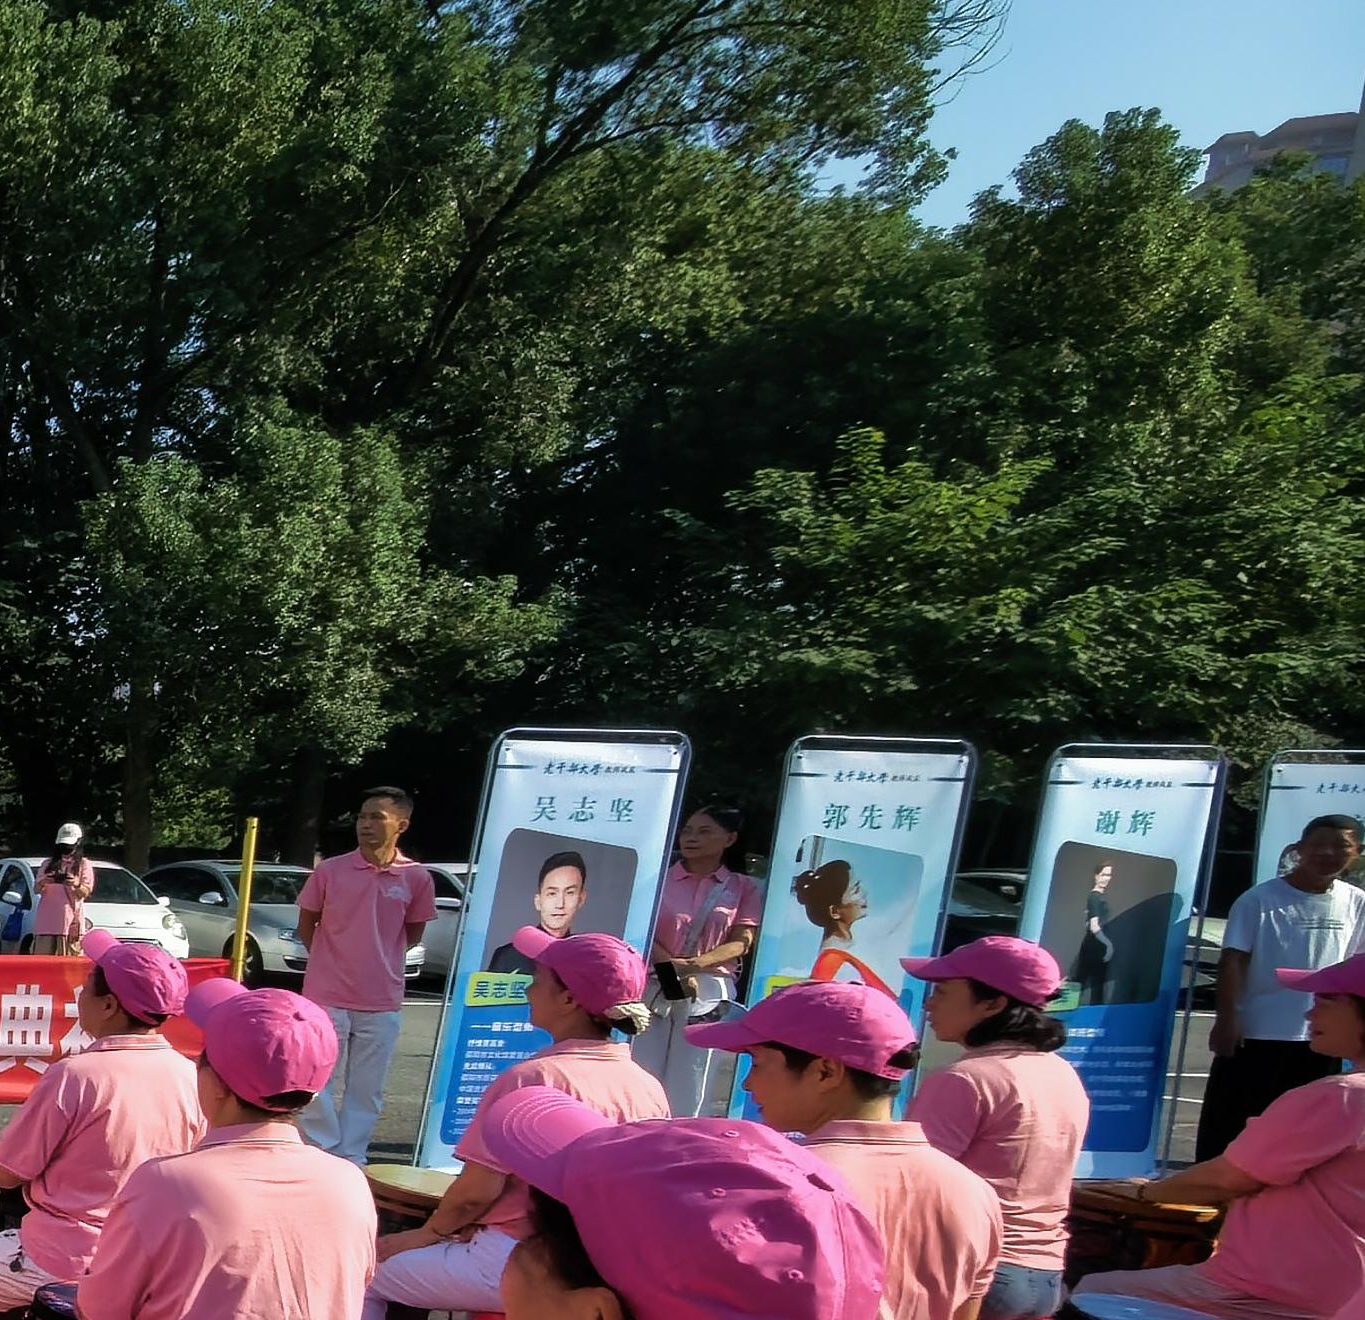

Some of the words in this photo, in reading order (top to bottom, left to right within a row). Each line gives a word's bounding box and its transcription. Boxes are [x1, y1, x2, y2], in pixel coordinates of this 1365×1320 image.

[1317, 782, 1365, 794] 老干部大
[530, 796, 634, 822] 吴志坚
[822, 803, 922, 831] 郭先辉
[1095, 809, 1156, 836] 谢辉
[473, 981, 527, 999] 吴志坚
